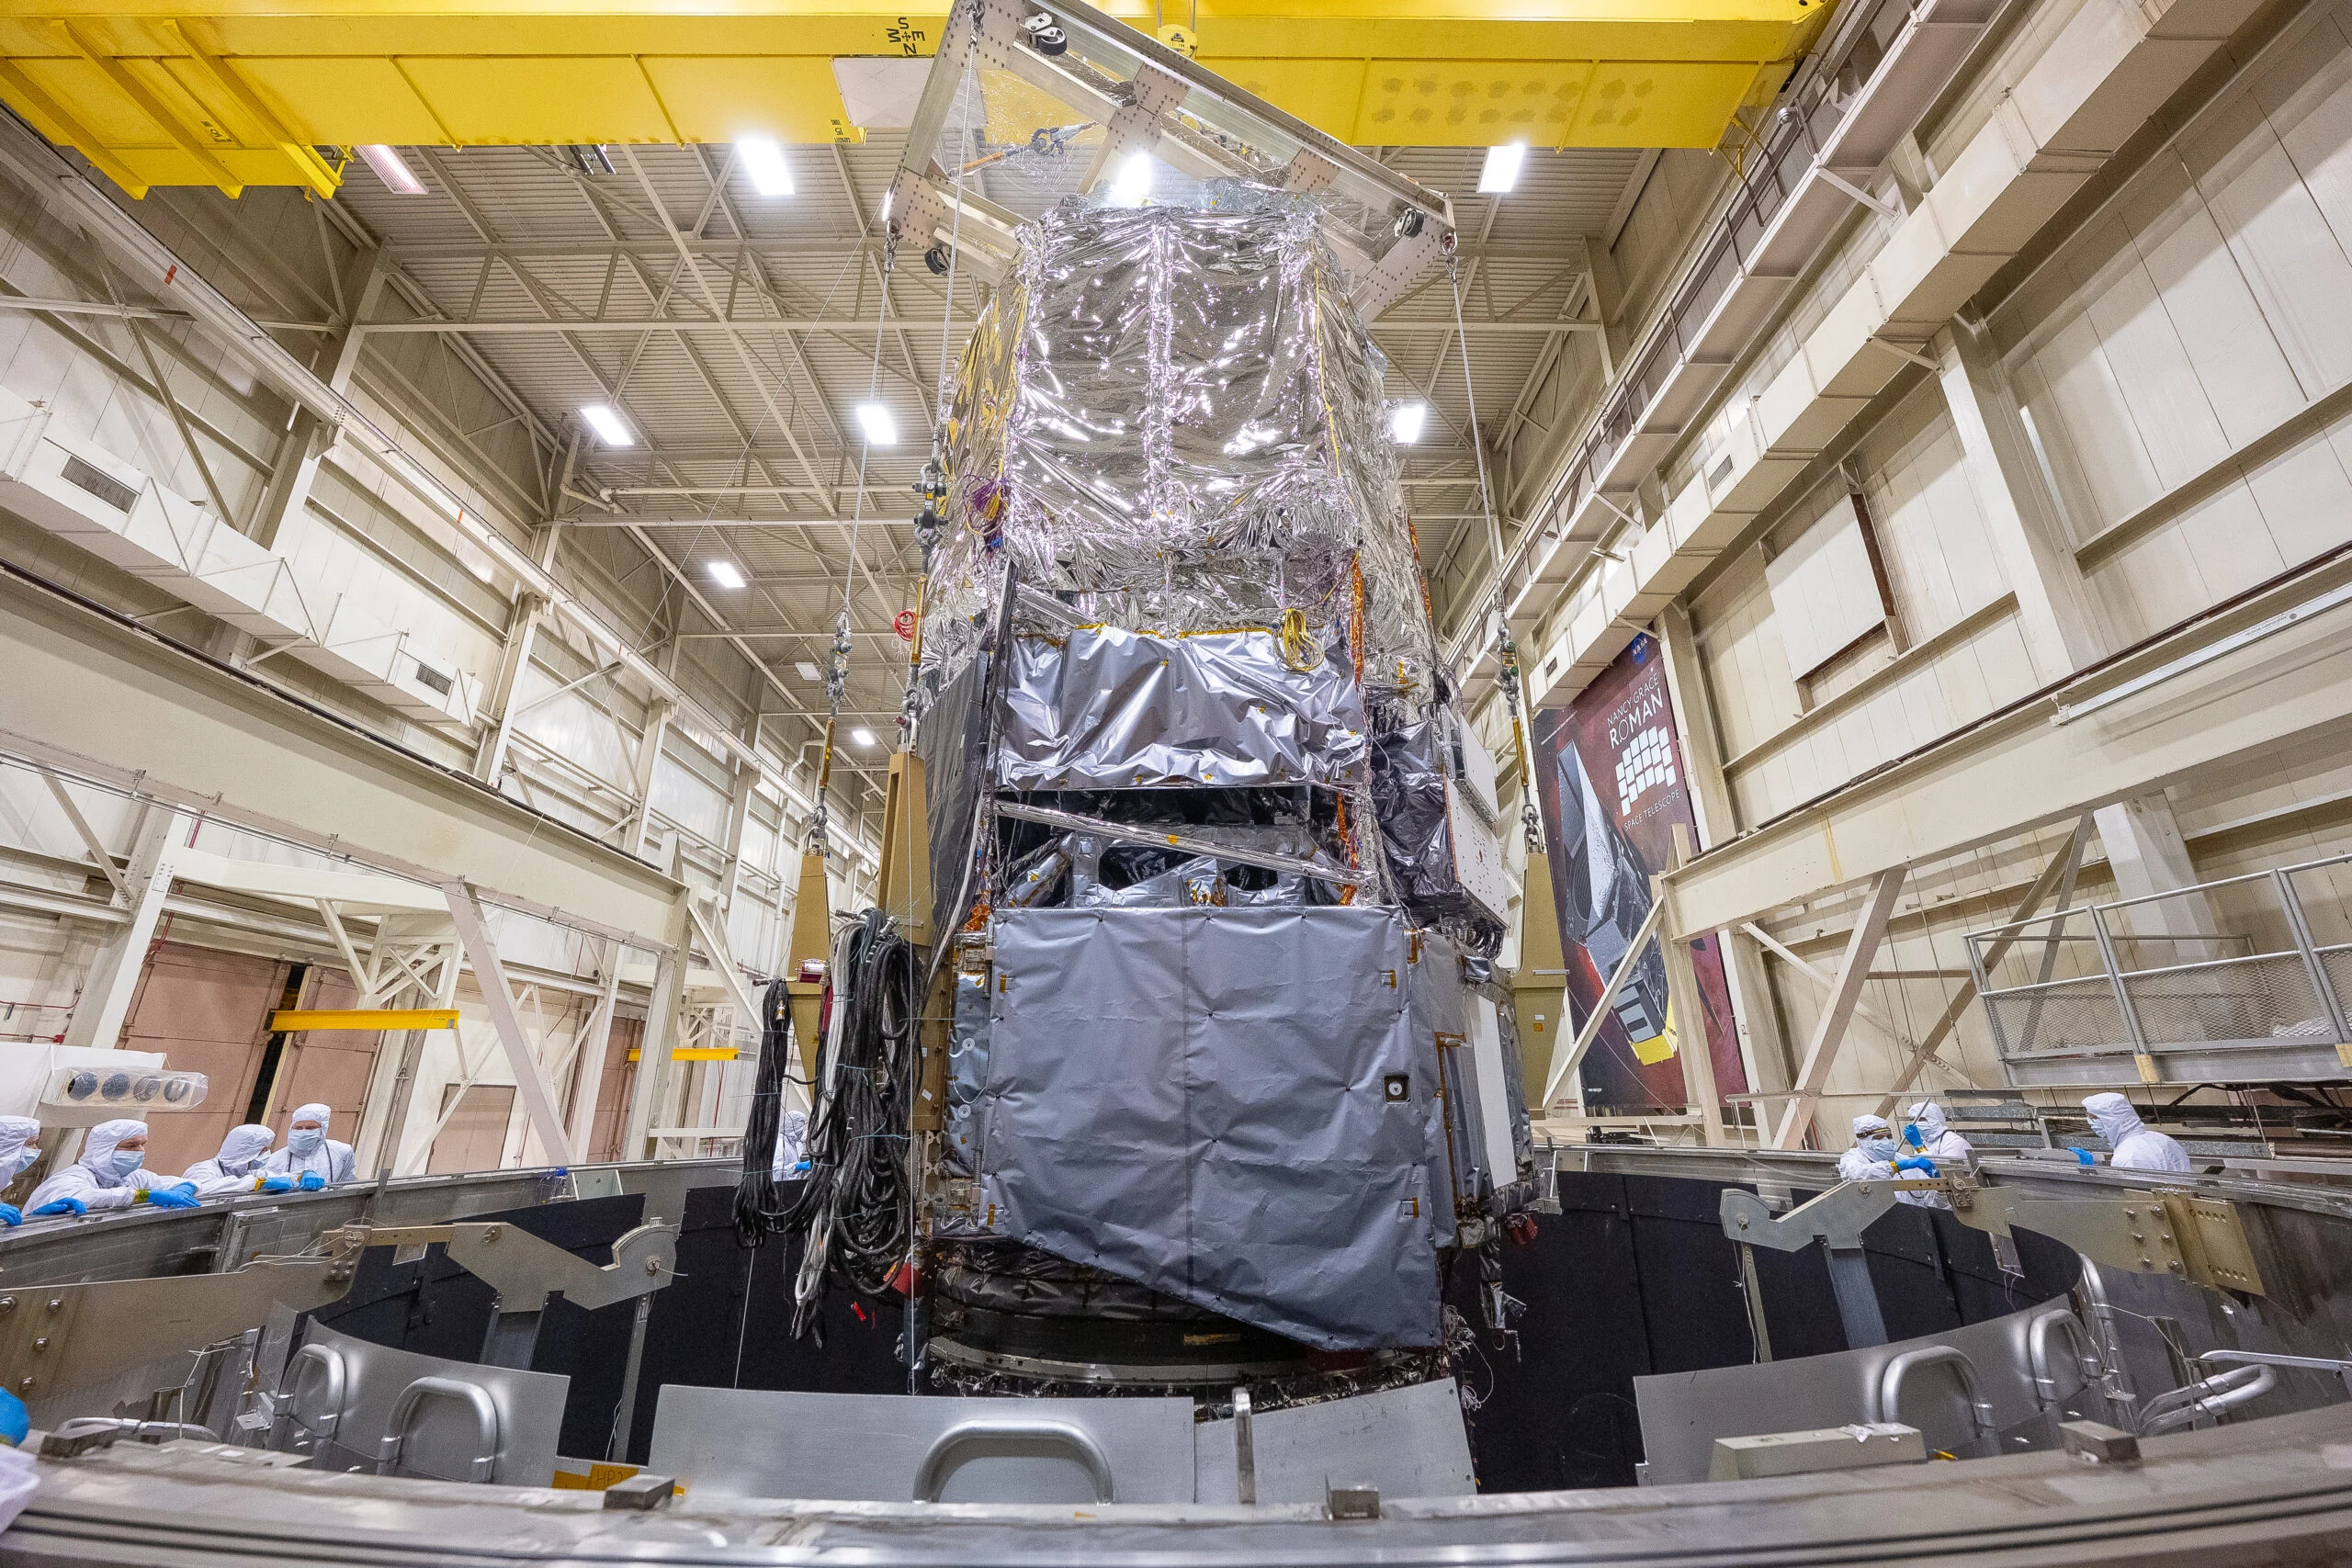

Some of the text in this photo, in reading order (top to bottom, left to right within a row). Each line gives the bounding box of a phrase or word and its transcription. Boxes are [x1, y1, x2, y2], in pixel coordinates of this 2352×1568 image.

[898, 17, 910, 29] S
[886, 28, 901, 43] W
[911, 30, 926, 42] E
[903, 42, 917, 55] N
[834, 127, 844, 136] 15
[1633, 637, 1647, 656] NASA
[1607, 696, 1632, 728] NANCY
[1633, 672, 1659, 704] GRACE
[1609, 687, 1664, 750] ROMAN
[1623, 788, 1680, 831] SPACE TELESCOPE
